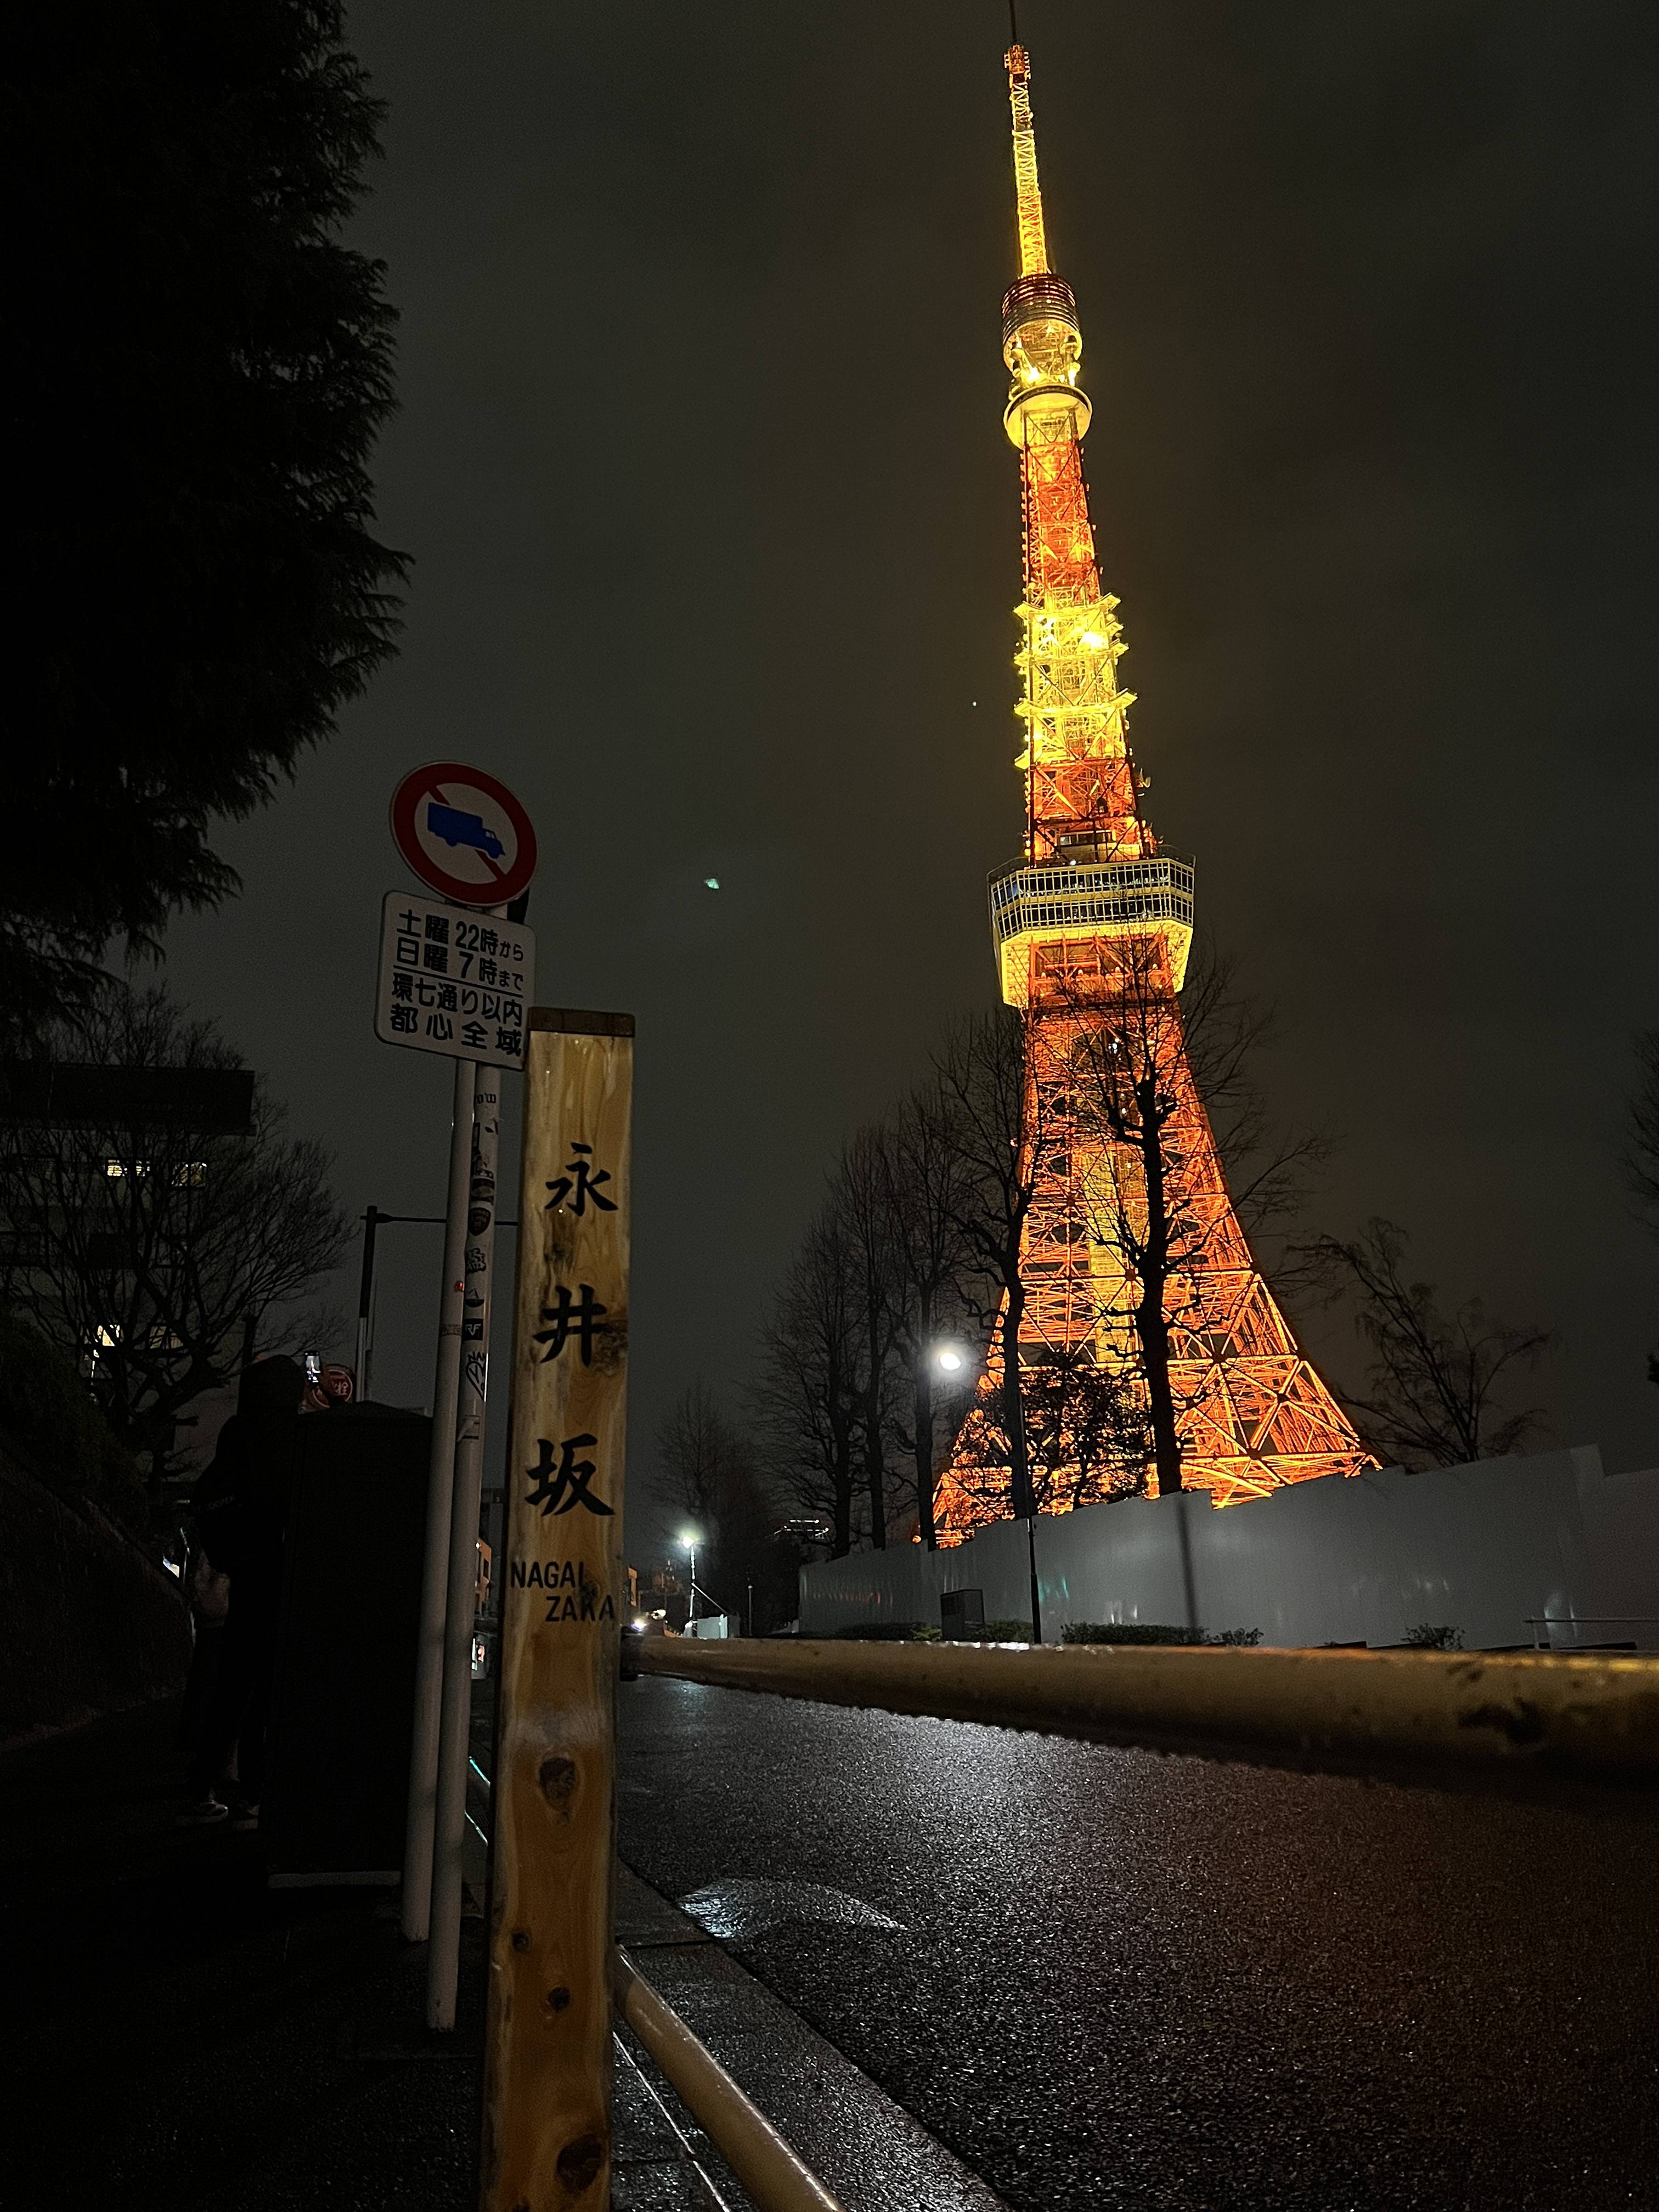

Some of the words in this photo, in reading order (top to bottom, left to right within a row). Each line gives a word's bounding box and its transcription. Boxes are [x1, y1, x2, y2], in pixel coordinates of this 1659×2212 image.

[392, 972, 522, 1027] 環七通り以内
[390, 1003, 521, 1057] 都心全域
[524, 1142, 618, 1517] 永井坂
[511, 1561, 584, 1588] NAGAI
[545, 1594, 614, 1622] ZAKA
